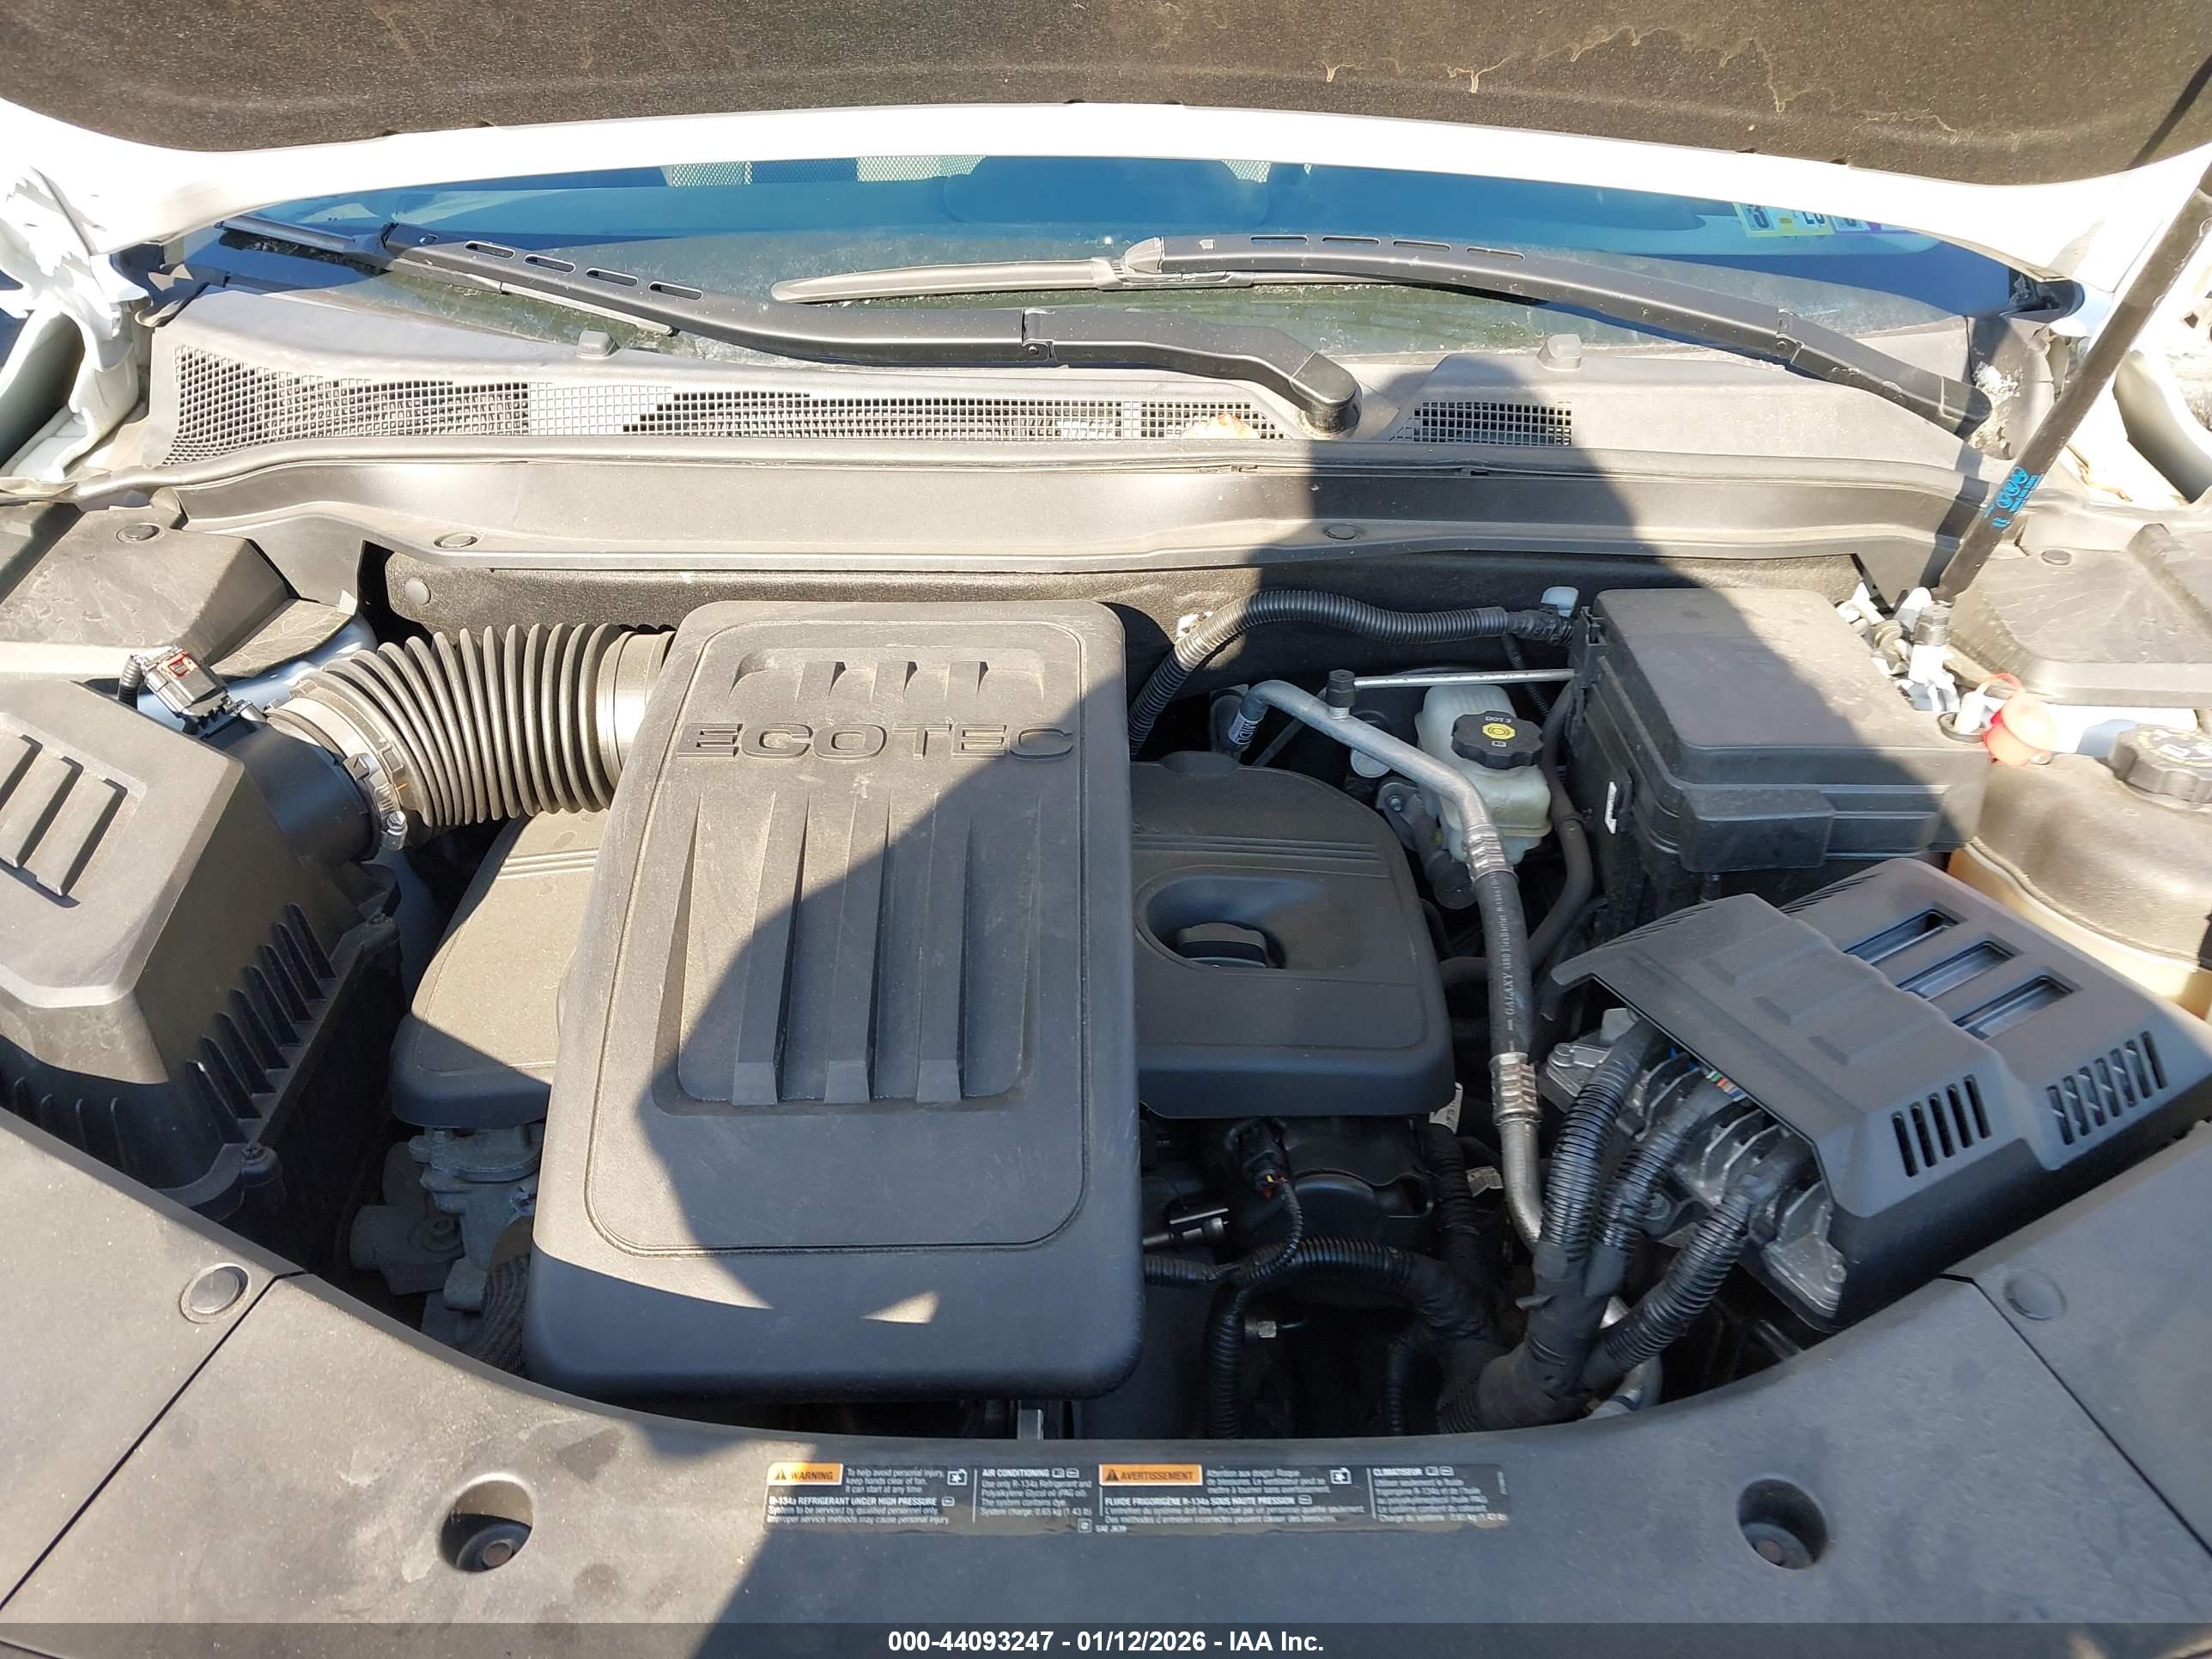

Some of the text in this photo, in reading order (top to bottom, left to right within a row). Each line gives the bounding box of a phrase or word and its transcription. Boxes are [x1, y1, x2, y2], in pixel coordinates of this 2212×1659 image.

[677, 723, 1073, 760] ECOTEC
[1504, 972, 1516, 1015] GALAXY
[790, 1471, 833, 1480] WARNING
[847, 1468, 855, 1477] To
[856, 1468, 872, 1477] help
[872, 1468, 892, 1477] avoid
[893, 1468, 922, 1477] personal
[981, 1468, 1050, 1477] AIR CONDITIONING
[1121, 1471, 1194, 1480] AVERTISSEMENT
[851, 1486, 865, 1494] can
[866, 1486, 883, 1494] start
[883, 1486, 890, 1494] at
[891, 1486, 904, 1494] any
[798, 1496, 850, 1506] REFRIGERANT
[851, 1496, 877, 1506] UNDER
[878, 1496, 896, 1506] HIGH
[897, 1496, 938, 1506] PRESSURE
